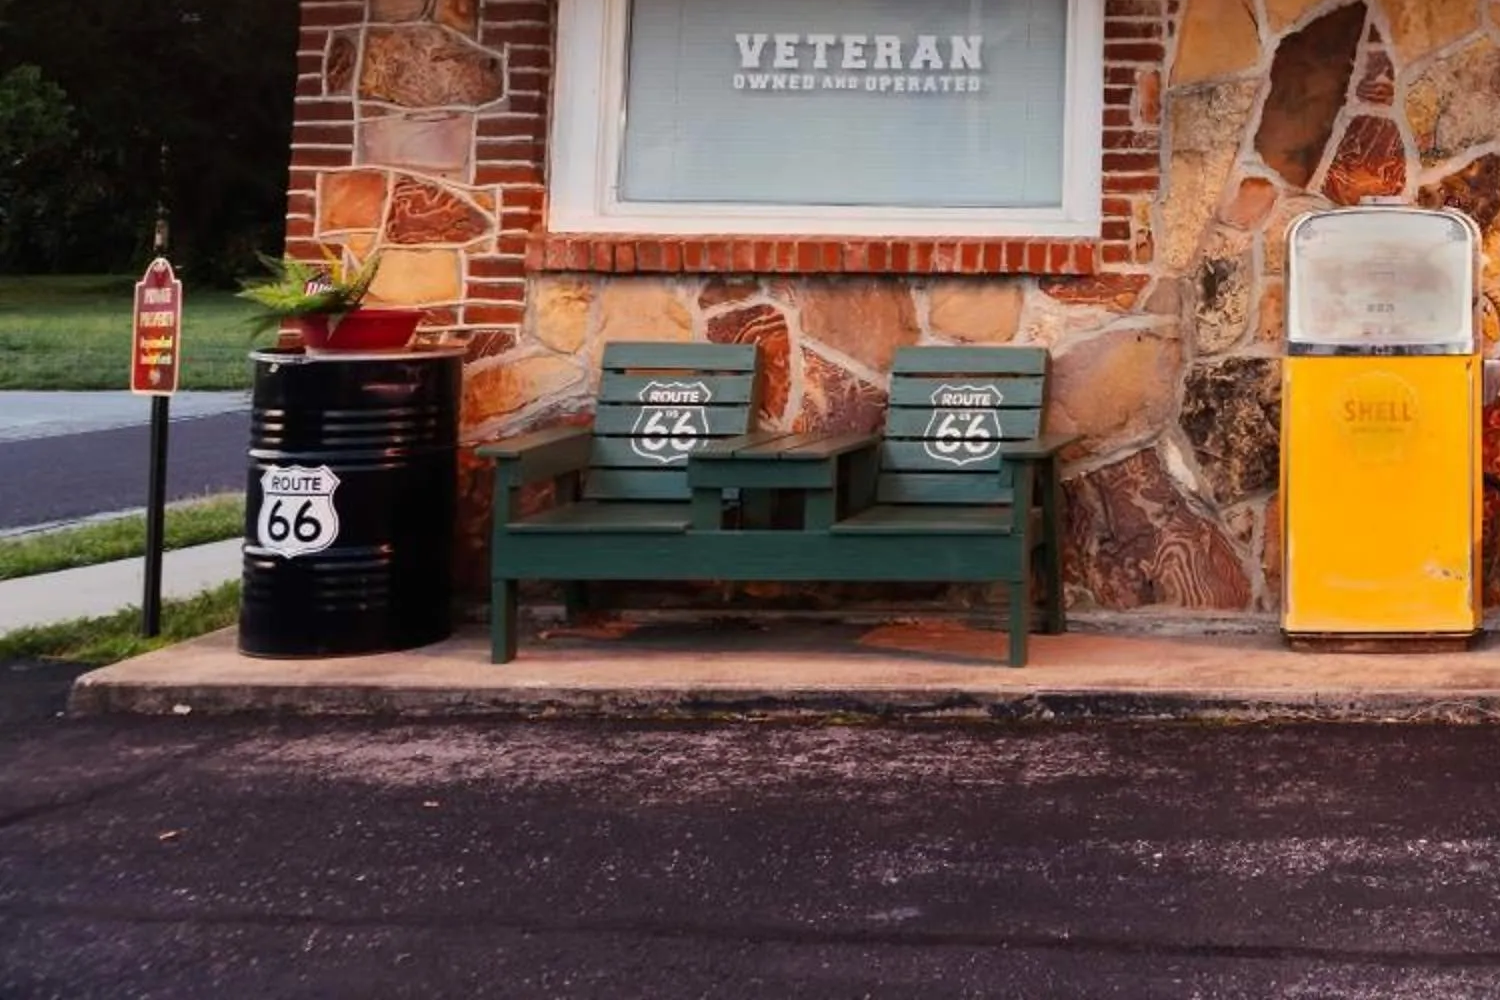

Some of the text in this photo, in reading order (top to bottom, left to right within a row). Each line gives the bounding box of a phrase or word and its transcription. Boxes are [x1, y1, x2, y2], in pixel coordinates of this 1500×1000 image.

[735, 33, 984, 69] VETERAN
[733, 74, 981, 92] OWNED AND OPERATED
[648, 390, 700, 403] ROUTE
[941, 393, 992, 406] ROUTE
[1344, 399, 1413, 422] SHELL
[641, 411, 698, 451] 66
[935, 413, 991, 453] 66
[271, 476, 322, 491] ROUTE
[268, 499, 323, 542] 66
